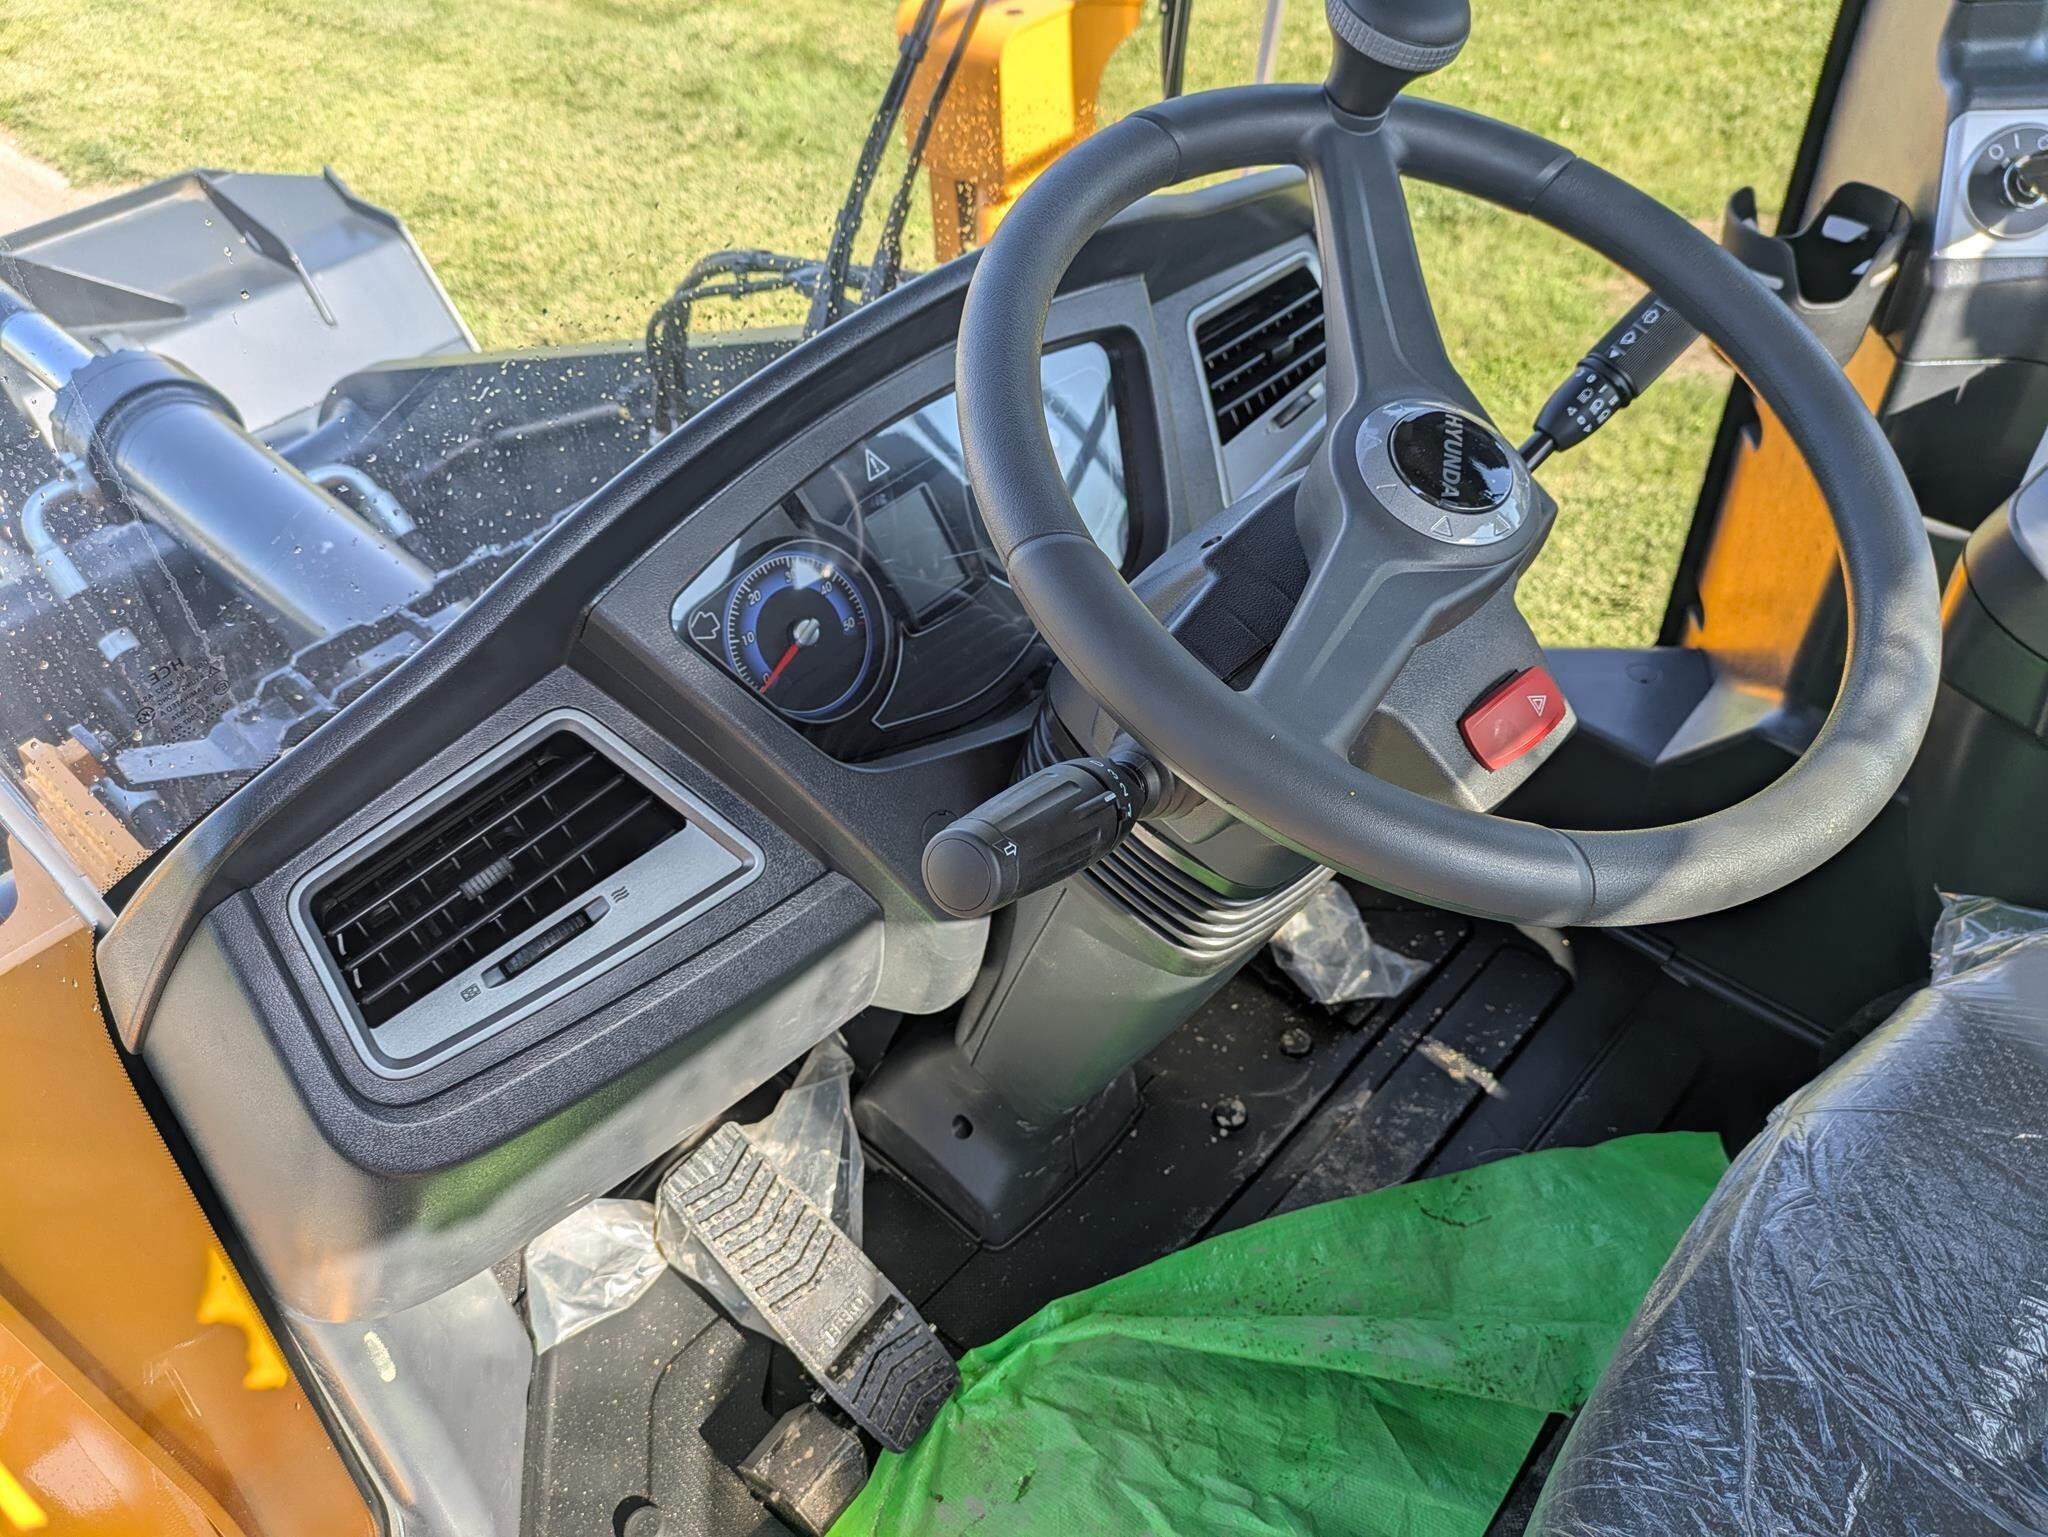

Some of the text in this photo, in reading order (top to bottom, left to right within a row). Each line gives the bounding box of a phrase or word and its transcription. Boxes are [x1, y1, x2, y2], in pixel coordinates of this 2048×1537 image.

[1440, 413, 1463, 506] HYUNDAI
[820, 581, 833, 596] 40
[747, 590, 761, 605] 20
[842, 616, 855, 632] 50
[741, 632, 755, 646] 10
